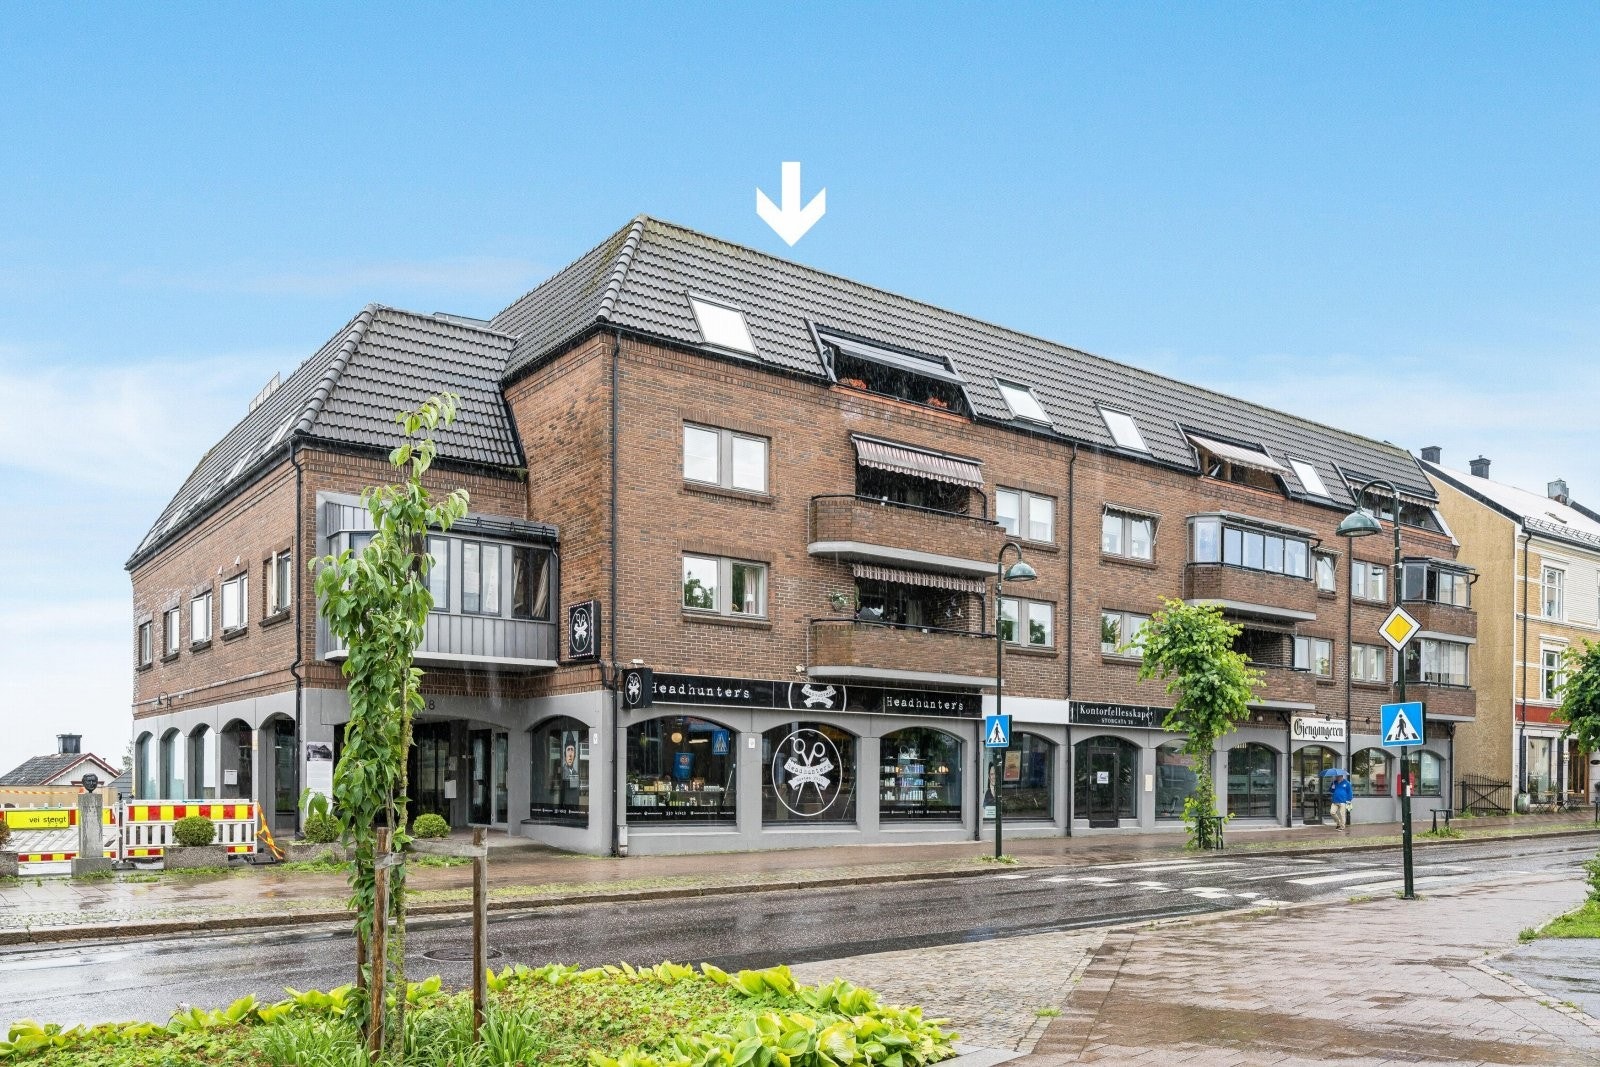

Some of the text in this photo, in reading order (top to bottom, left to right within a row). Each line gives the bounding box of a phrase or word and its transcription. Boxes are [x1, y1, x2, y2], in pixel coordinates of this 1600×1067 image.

[886, 696, 964, 711] Headhunters
[1080, 704, 1153, 721] Kontorfellesskapet
[1294, 718, 1344, 740] Gjengangeren
[43, 816, 67, 824] stengt
